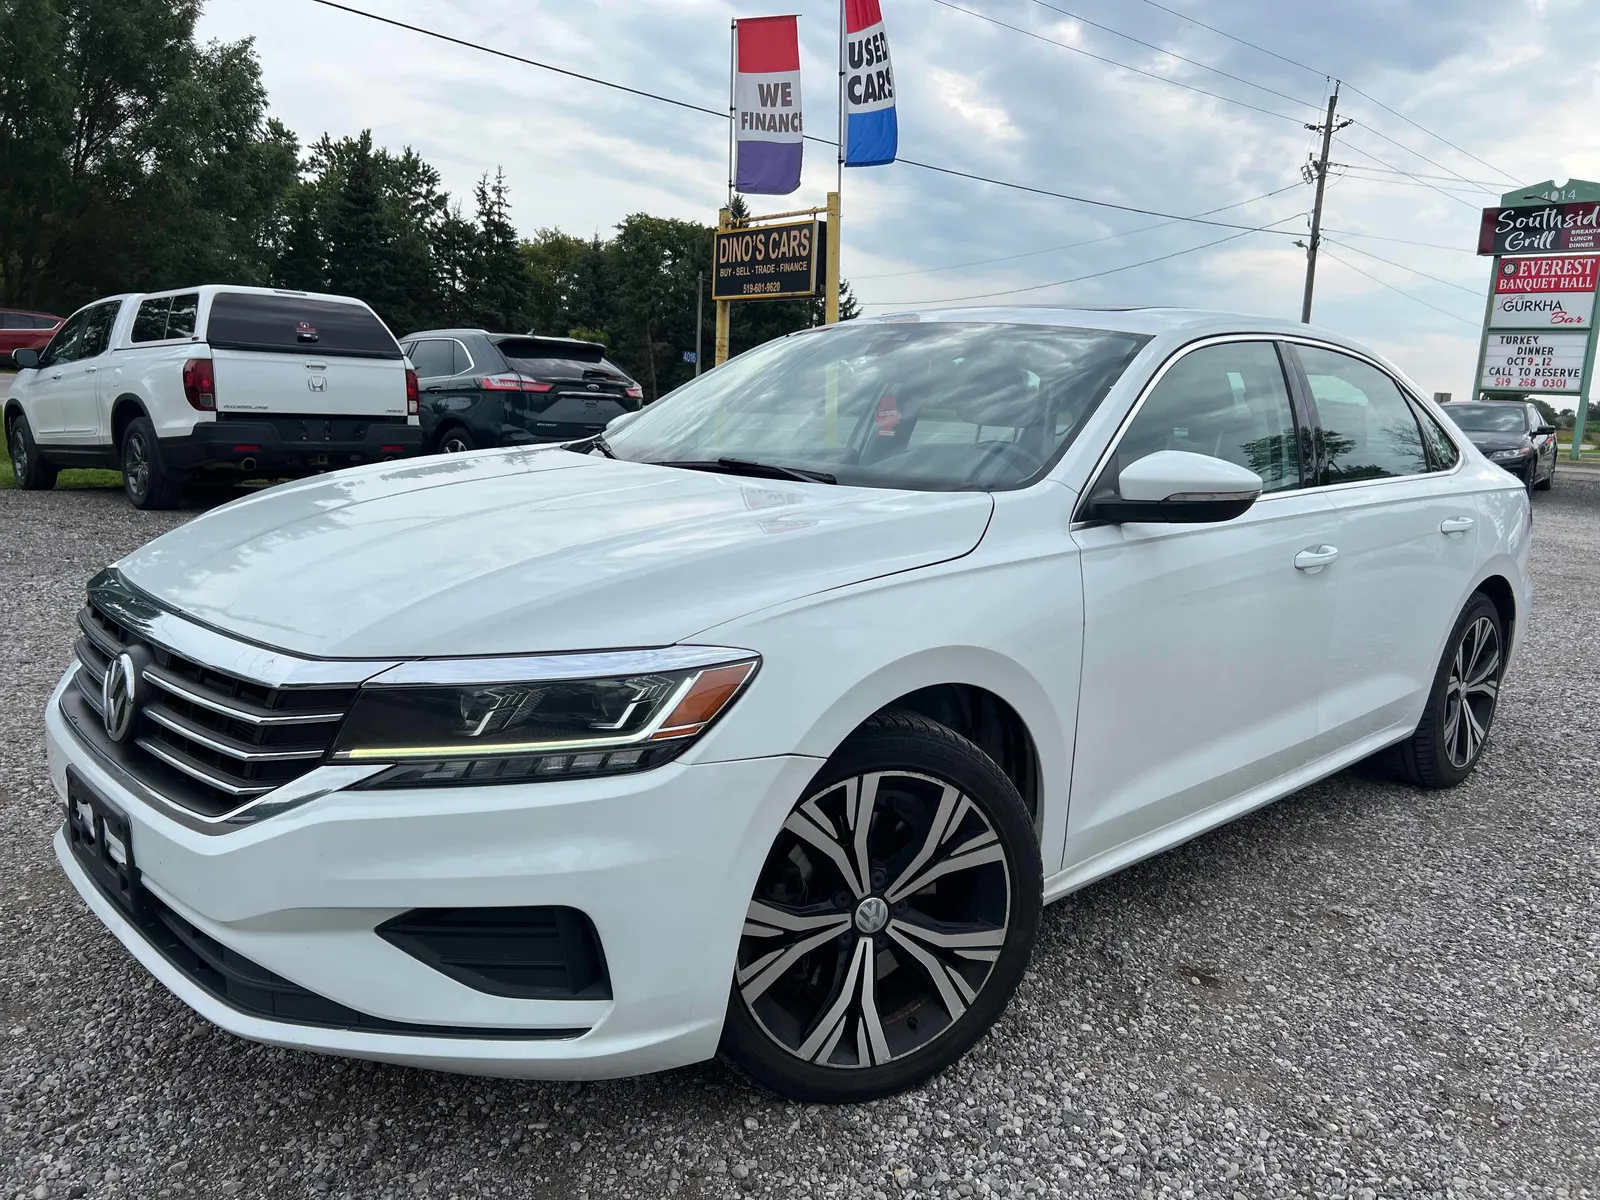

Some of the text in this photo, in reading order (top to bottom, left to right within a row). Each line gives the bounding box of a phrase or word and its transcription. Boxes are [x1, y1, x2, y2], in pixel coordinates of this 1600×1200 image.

[848, 32, 888, 70] USED
[847, 67, 893, 105] CARS
[757, 82, 793, 107] WE
[1495, 206, 1600, 233] Southsid
[720, 229, 809, 263] DINO'S CARS
[1504, 230, 1556, 251] Grill
[720, 268, 732, 277] BUY
[736, 267, 751, 276] SELL
[755, 264, 776, 274] TRADE
[780, 261, 808, 272] FINANCE
[1518, 259, 1595, 276] EVEREST
[743, 282, 780, 294] 519-601-9620
[1499, 276, 1593, 291] BANQUET HALL
[1503, 300, 1563, 312] GURKHA
[1550, 311, 1584, 325] Bar
[1500, 335, 1539, 345] TURKEY
[1517, 346, 1554, 356] DINNER
[1507, 357, 1527, 366] OCT
[1489, 367, 1580, 377] CALL TO RESERVE
[1495, 378, 1567, 388] 519 268 0301
